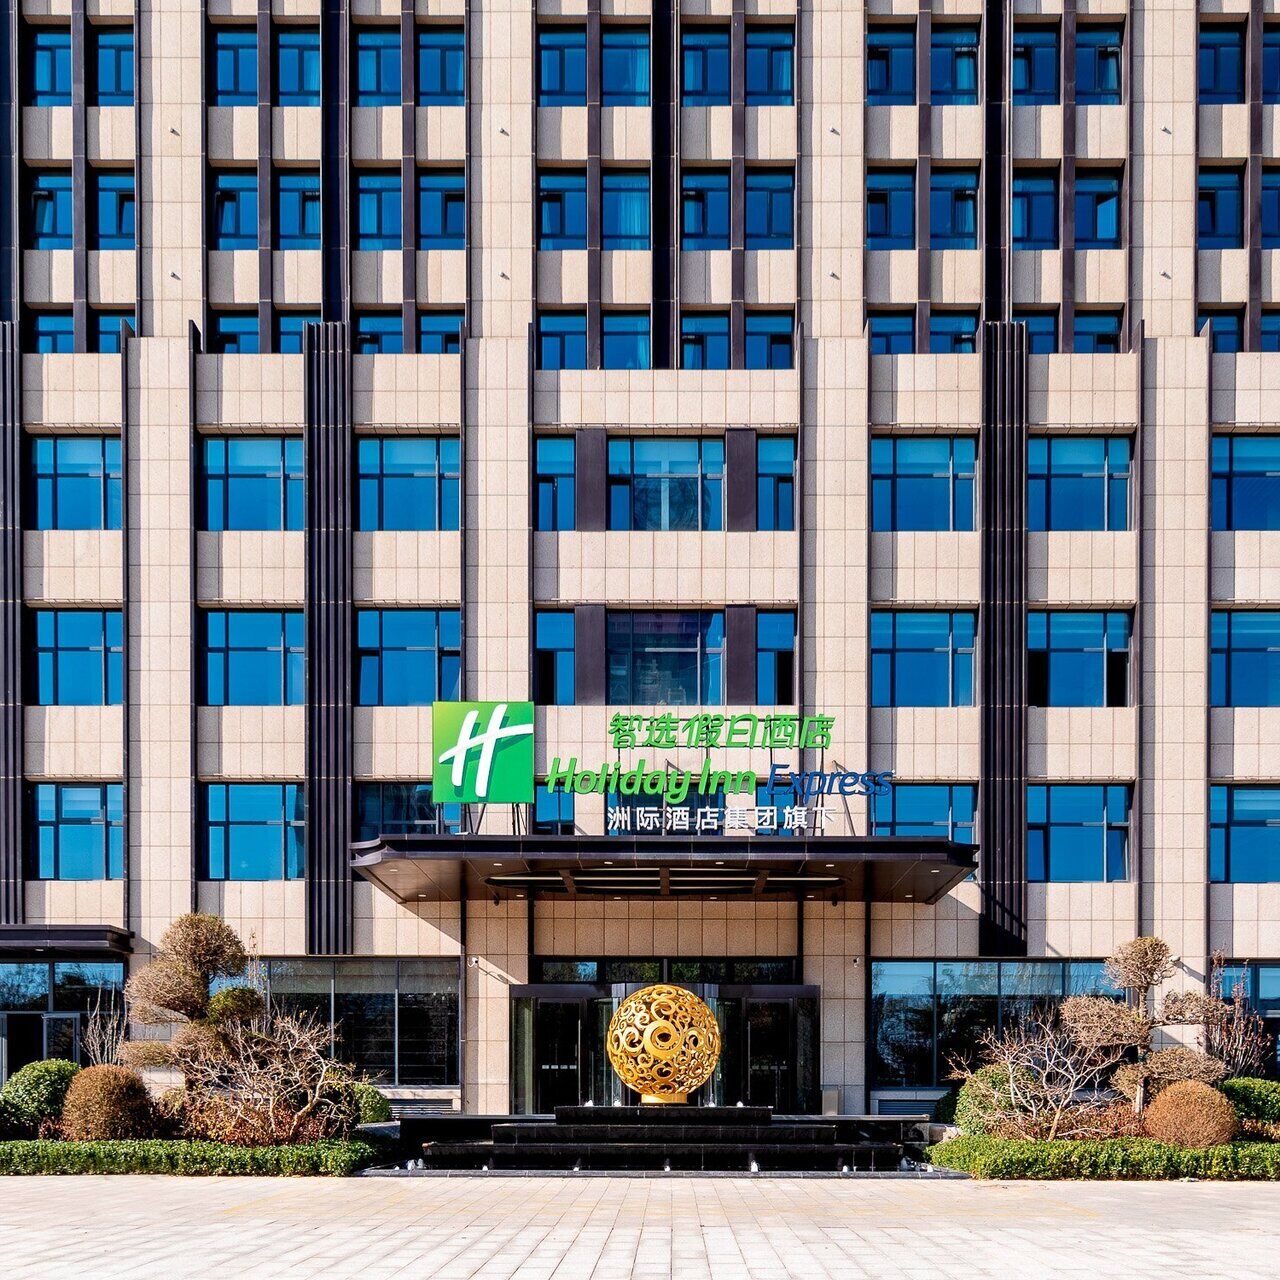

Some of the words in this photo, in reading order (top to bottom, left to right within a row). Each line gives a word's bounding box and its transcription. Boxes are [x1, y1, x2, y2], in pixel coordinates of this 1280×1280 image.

[607, 711, 836, 750] 智选假日酒店
[545, 757, 693, 804] Holiday
[697, 758, 757, 796] Inn
[765, 763, 894, 804] Express
[606, 805, 837, 831] 洲际酒店集团旗下
